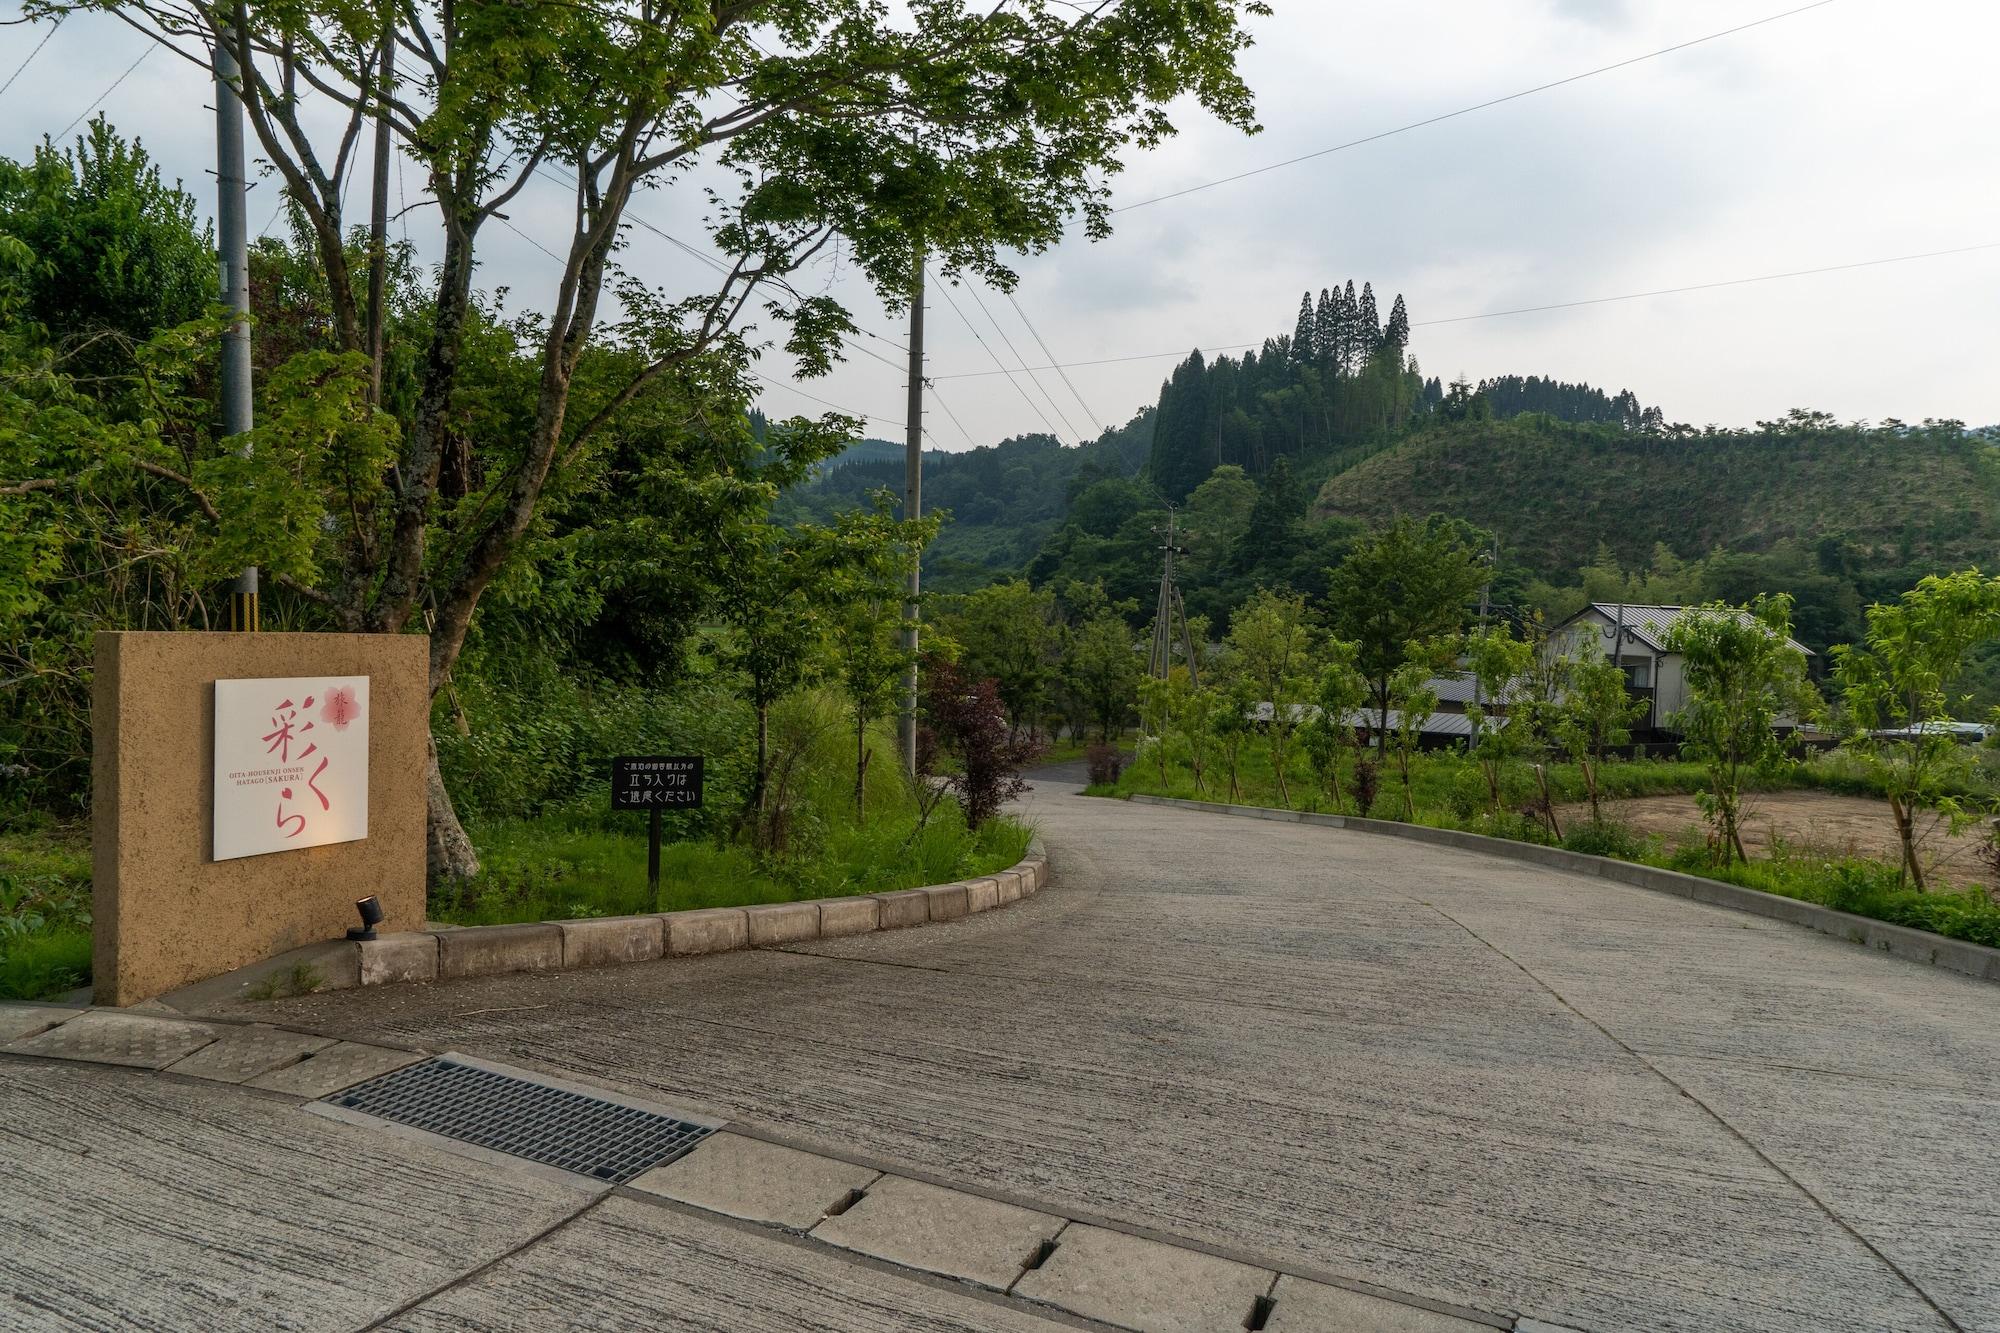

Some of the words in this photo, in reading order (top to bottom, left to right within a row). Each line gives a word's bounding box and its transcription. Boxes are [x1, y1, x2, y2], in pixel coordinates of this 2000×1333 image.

[261, 695, 330, 839] 彩くら
[282, 766, 304, 774] ONSEN
[629, 773, 687, 787] 立ち入りは
[619, 790, 696, 804] ご遠慮ください
